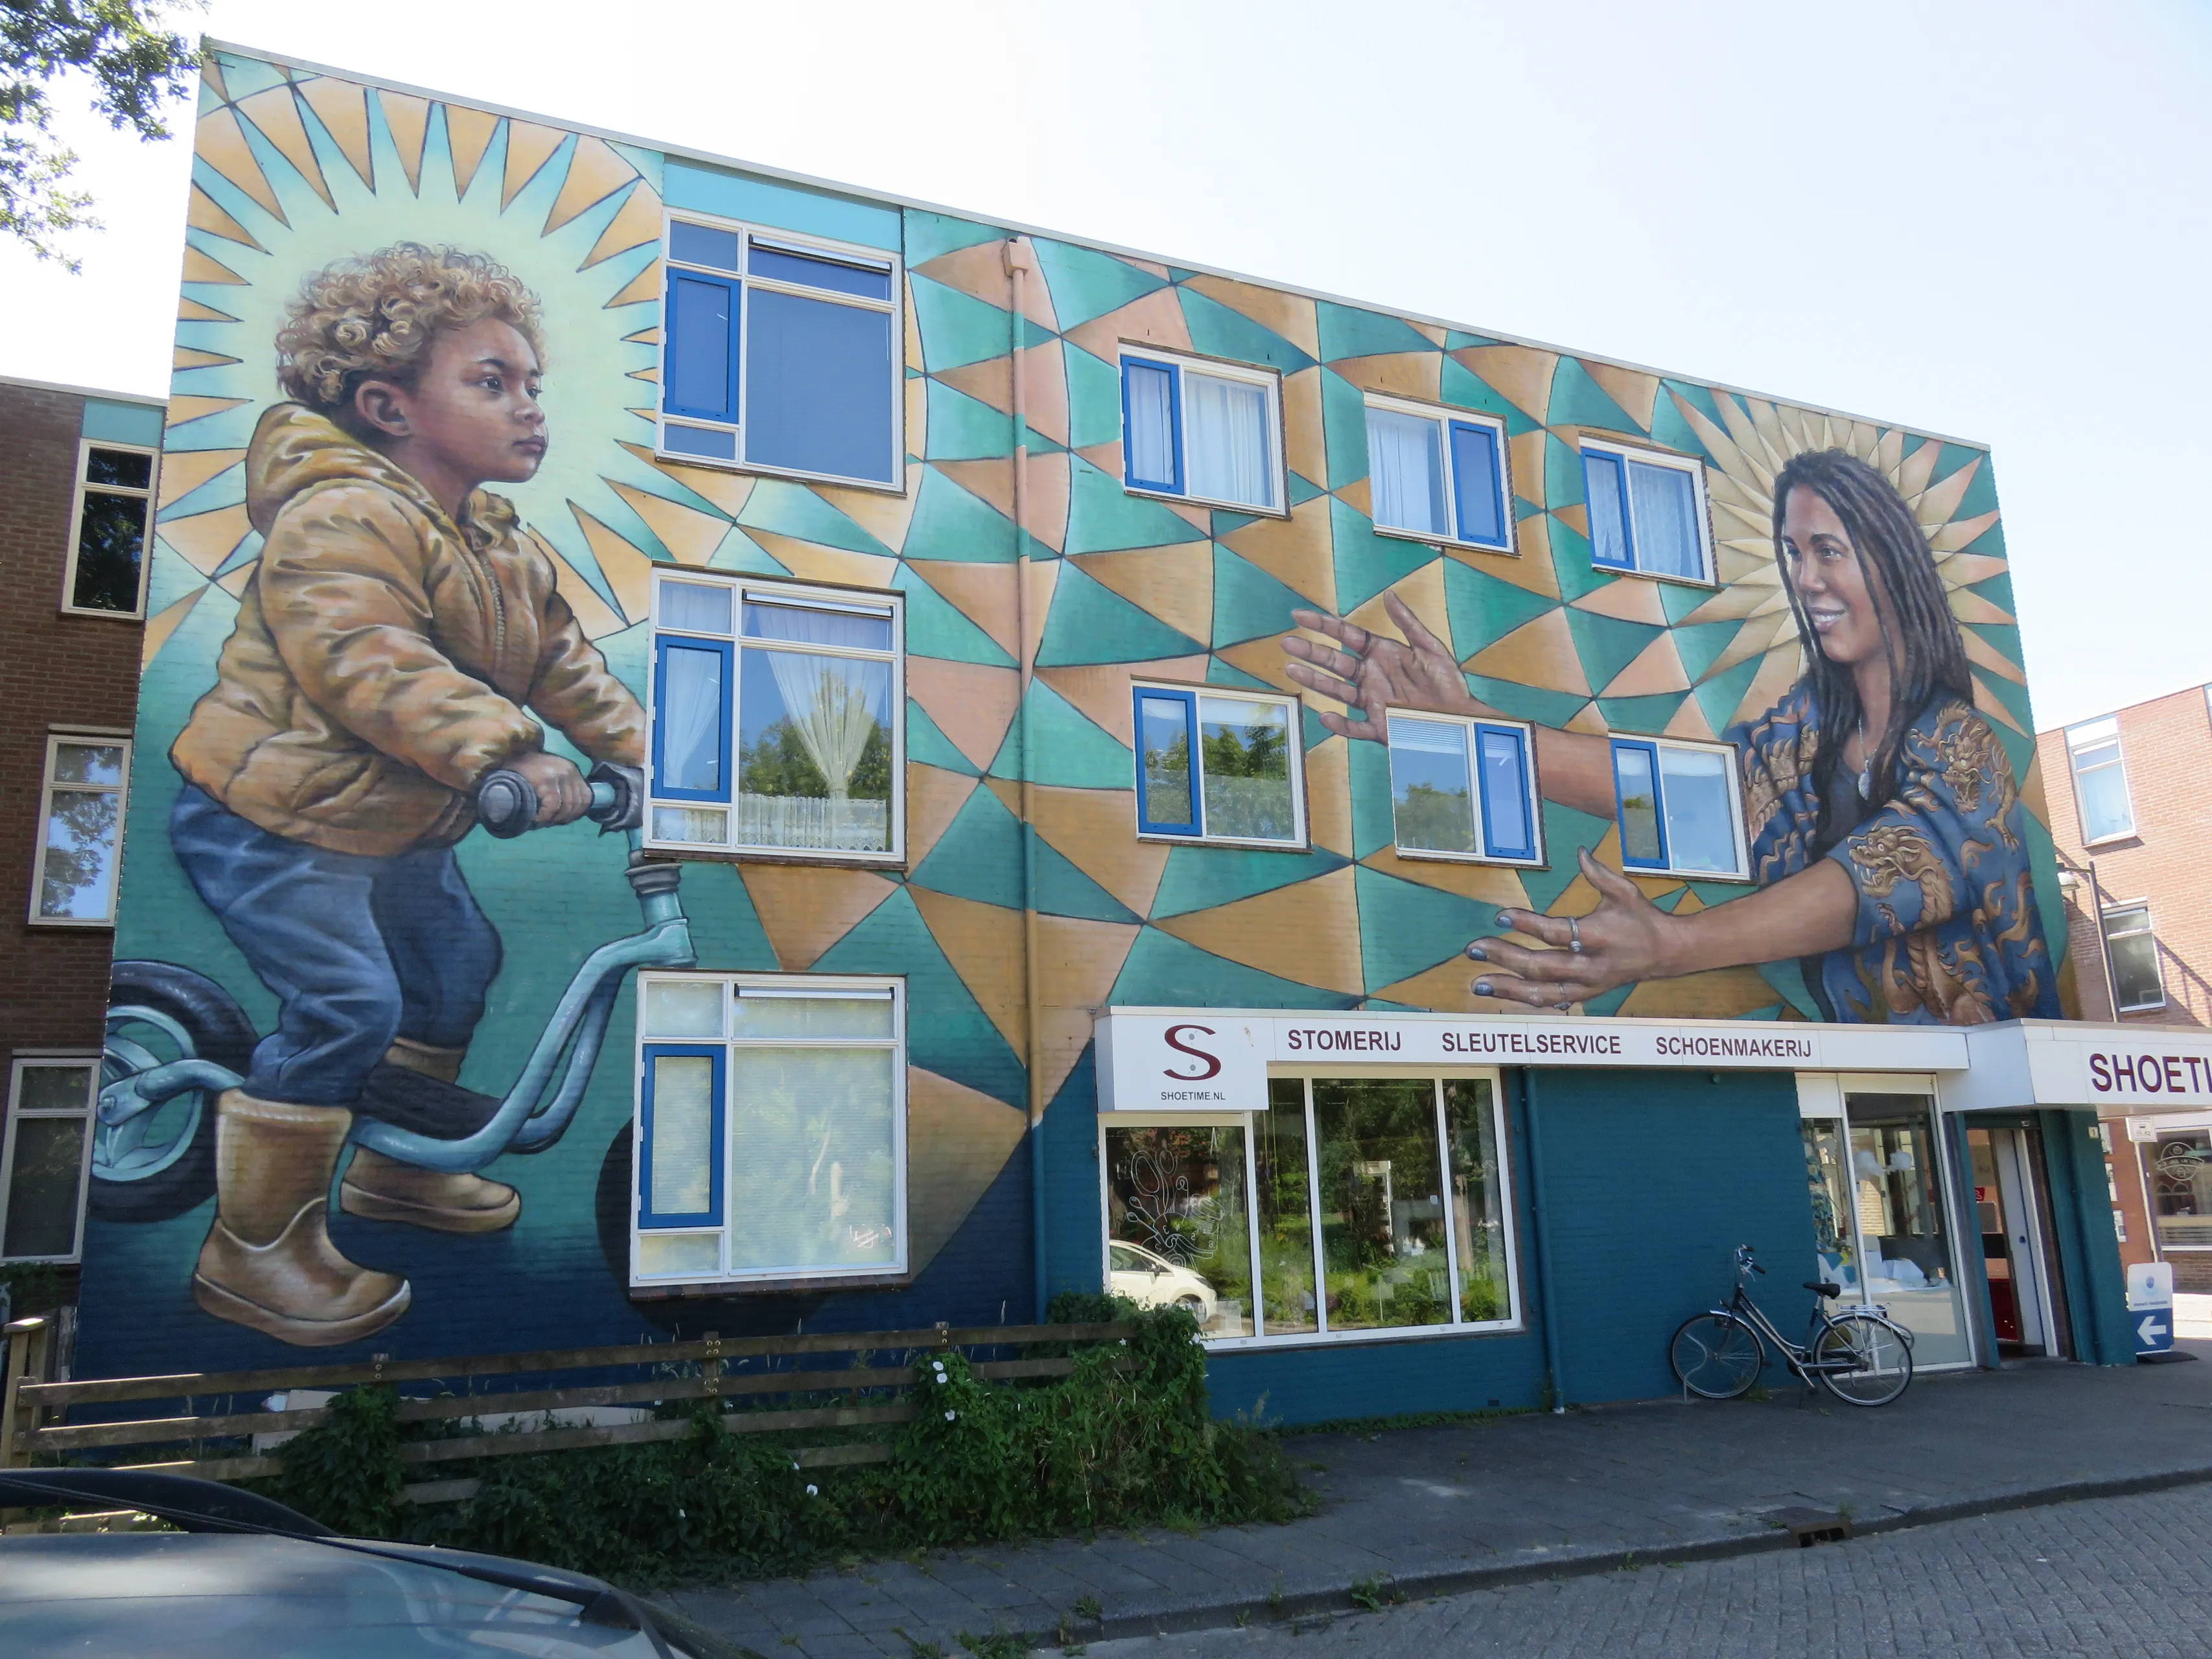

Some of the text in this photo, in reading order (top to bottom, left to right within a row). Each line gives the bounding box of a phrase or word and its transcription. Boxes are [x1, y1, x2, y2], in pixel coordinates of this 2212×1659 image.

[1163, 1024, 1222, 1081] S
[1287, 1028, 1812, 1058] STOMERIJ SLEUTELSERVICE SCHOENMAKERIJ
[2089, 1053, 2212, 1093] SHOETI
[1160, 1091, 1226, 1101] SHOETIME.NL
